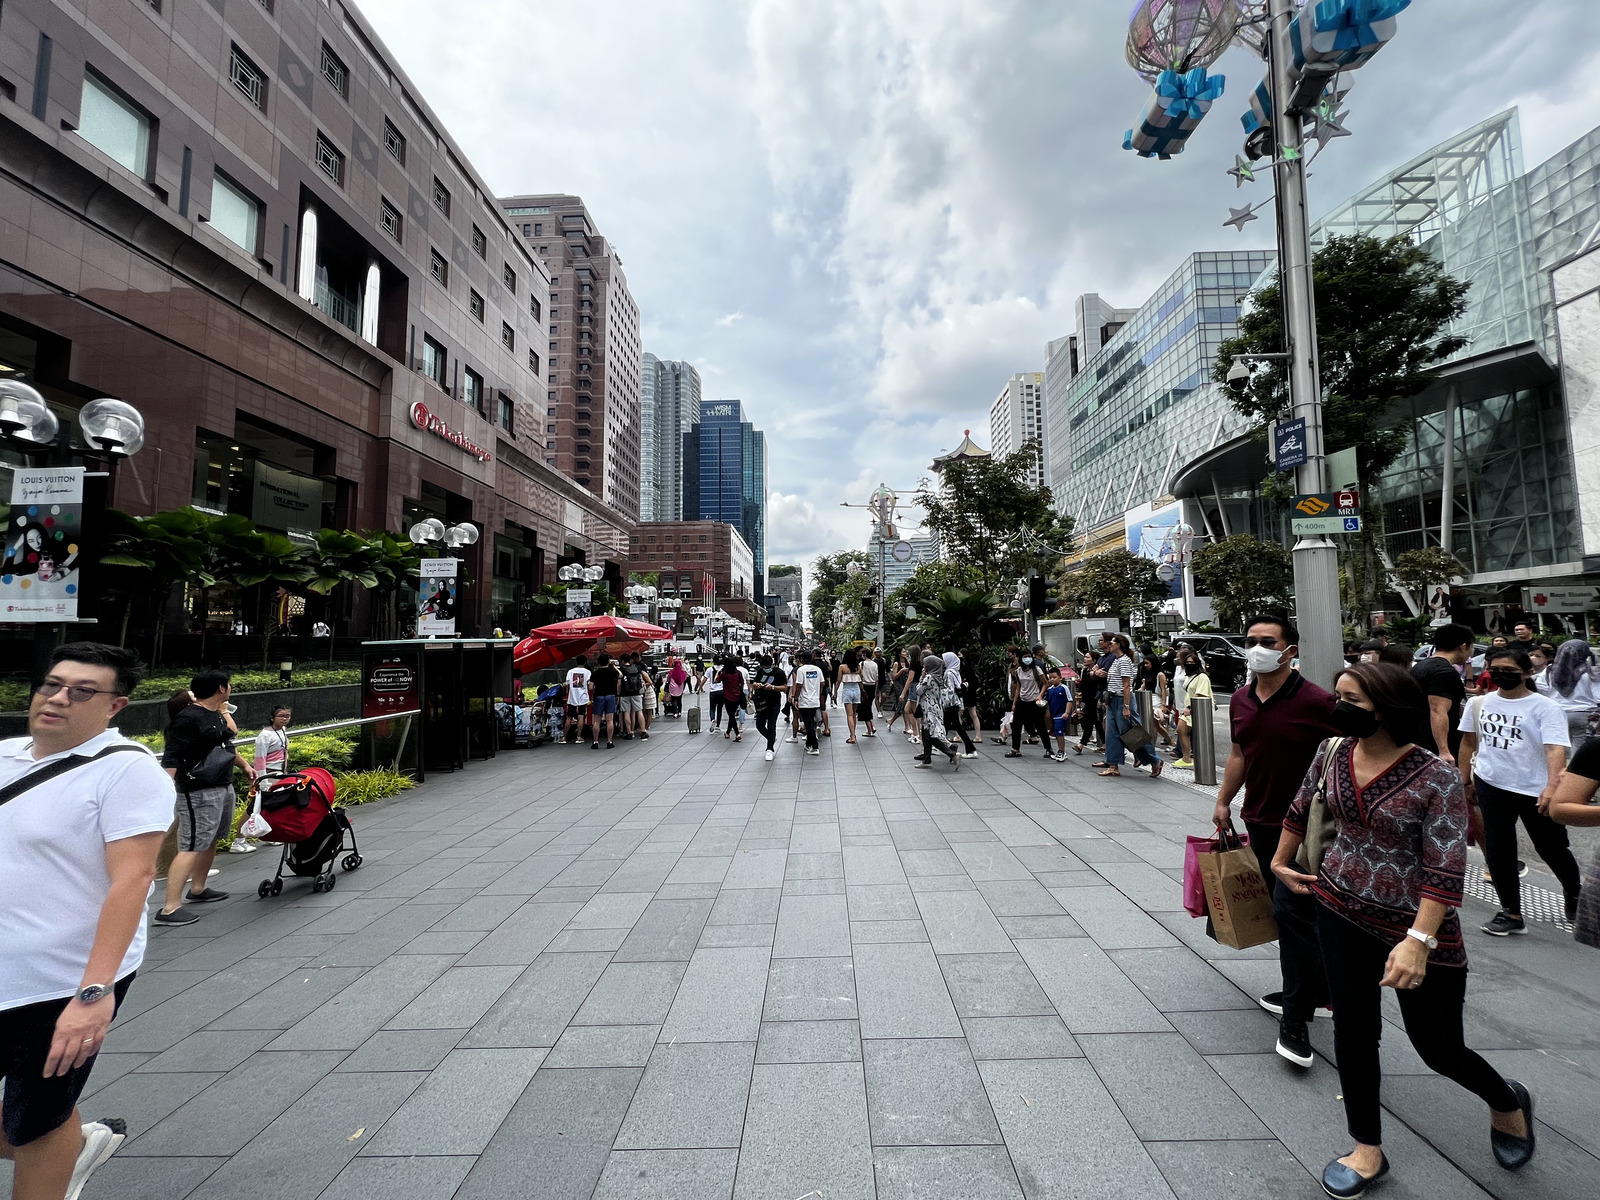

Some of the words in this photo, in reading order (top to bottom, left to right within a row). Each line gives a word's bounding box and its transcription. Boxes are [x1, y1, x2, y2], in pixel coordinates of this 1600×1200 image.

[1285, 423, 1302, 433] POLICE
[428, 413, 491, 462] Takashimaya
[1280, 455, 1297, 463] CAMERA
[1280, 458, 1303, 468] OPERATION
[45, 475, 75, 483] VUITTON
[260, 480, 300, 498] INTERNATIONAL
[273, 495, 309, 508] COLLECTION
